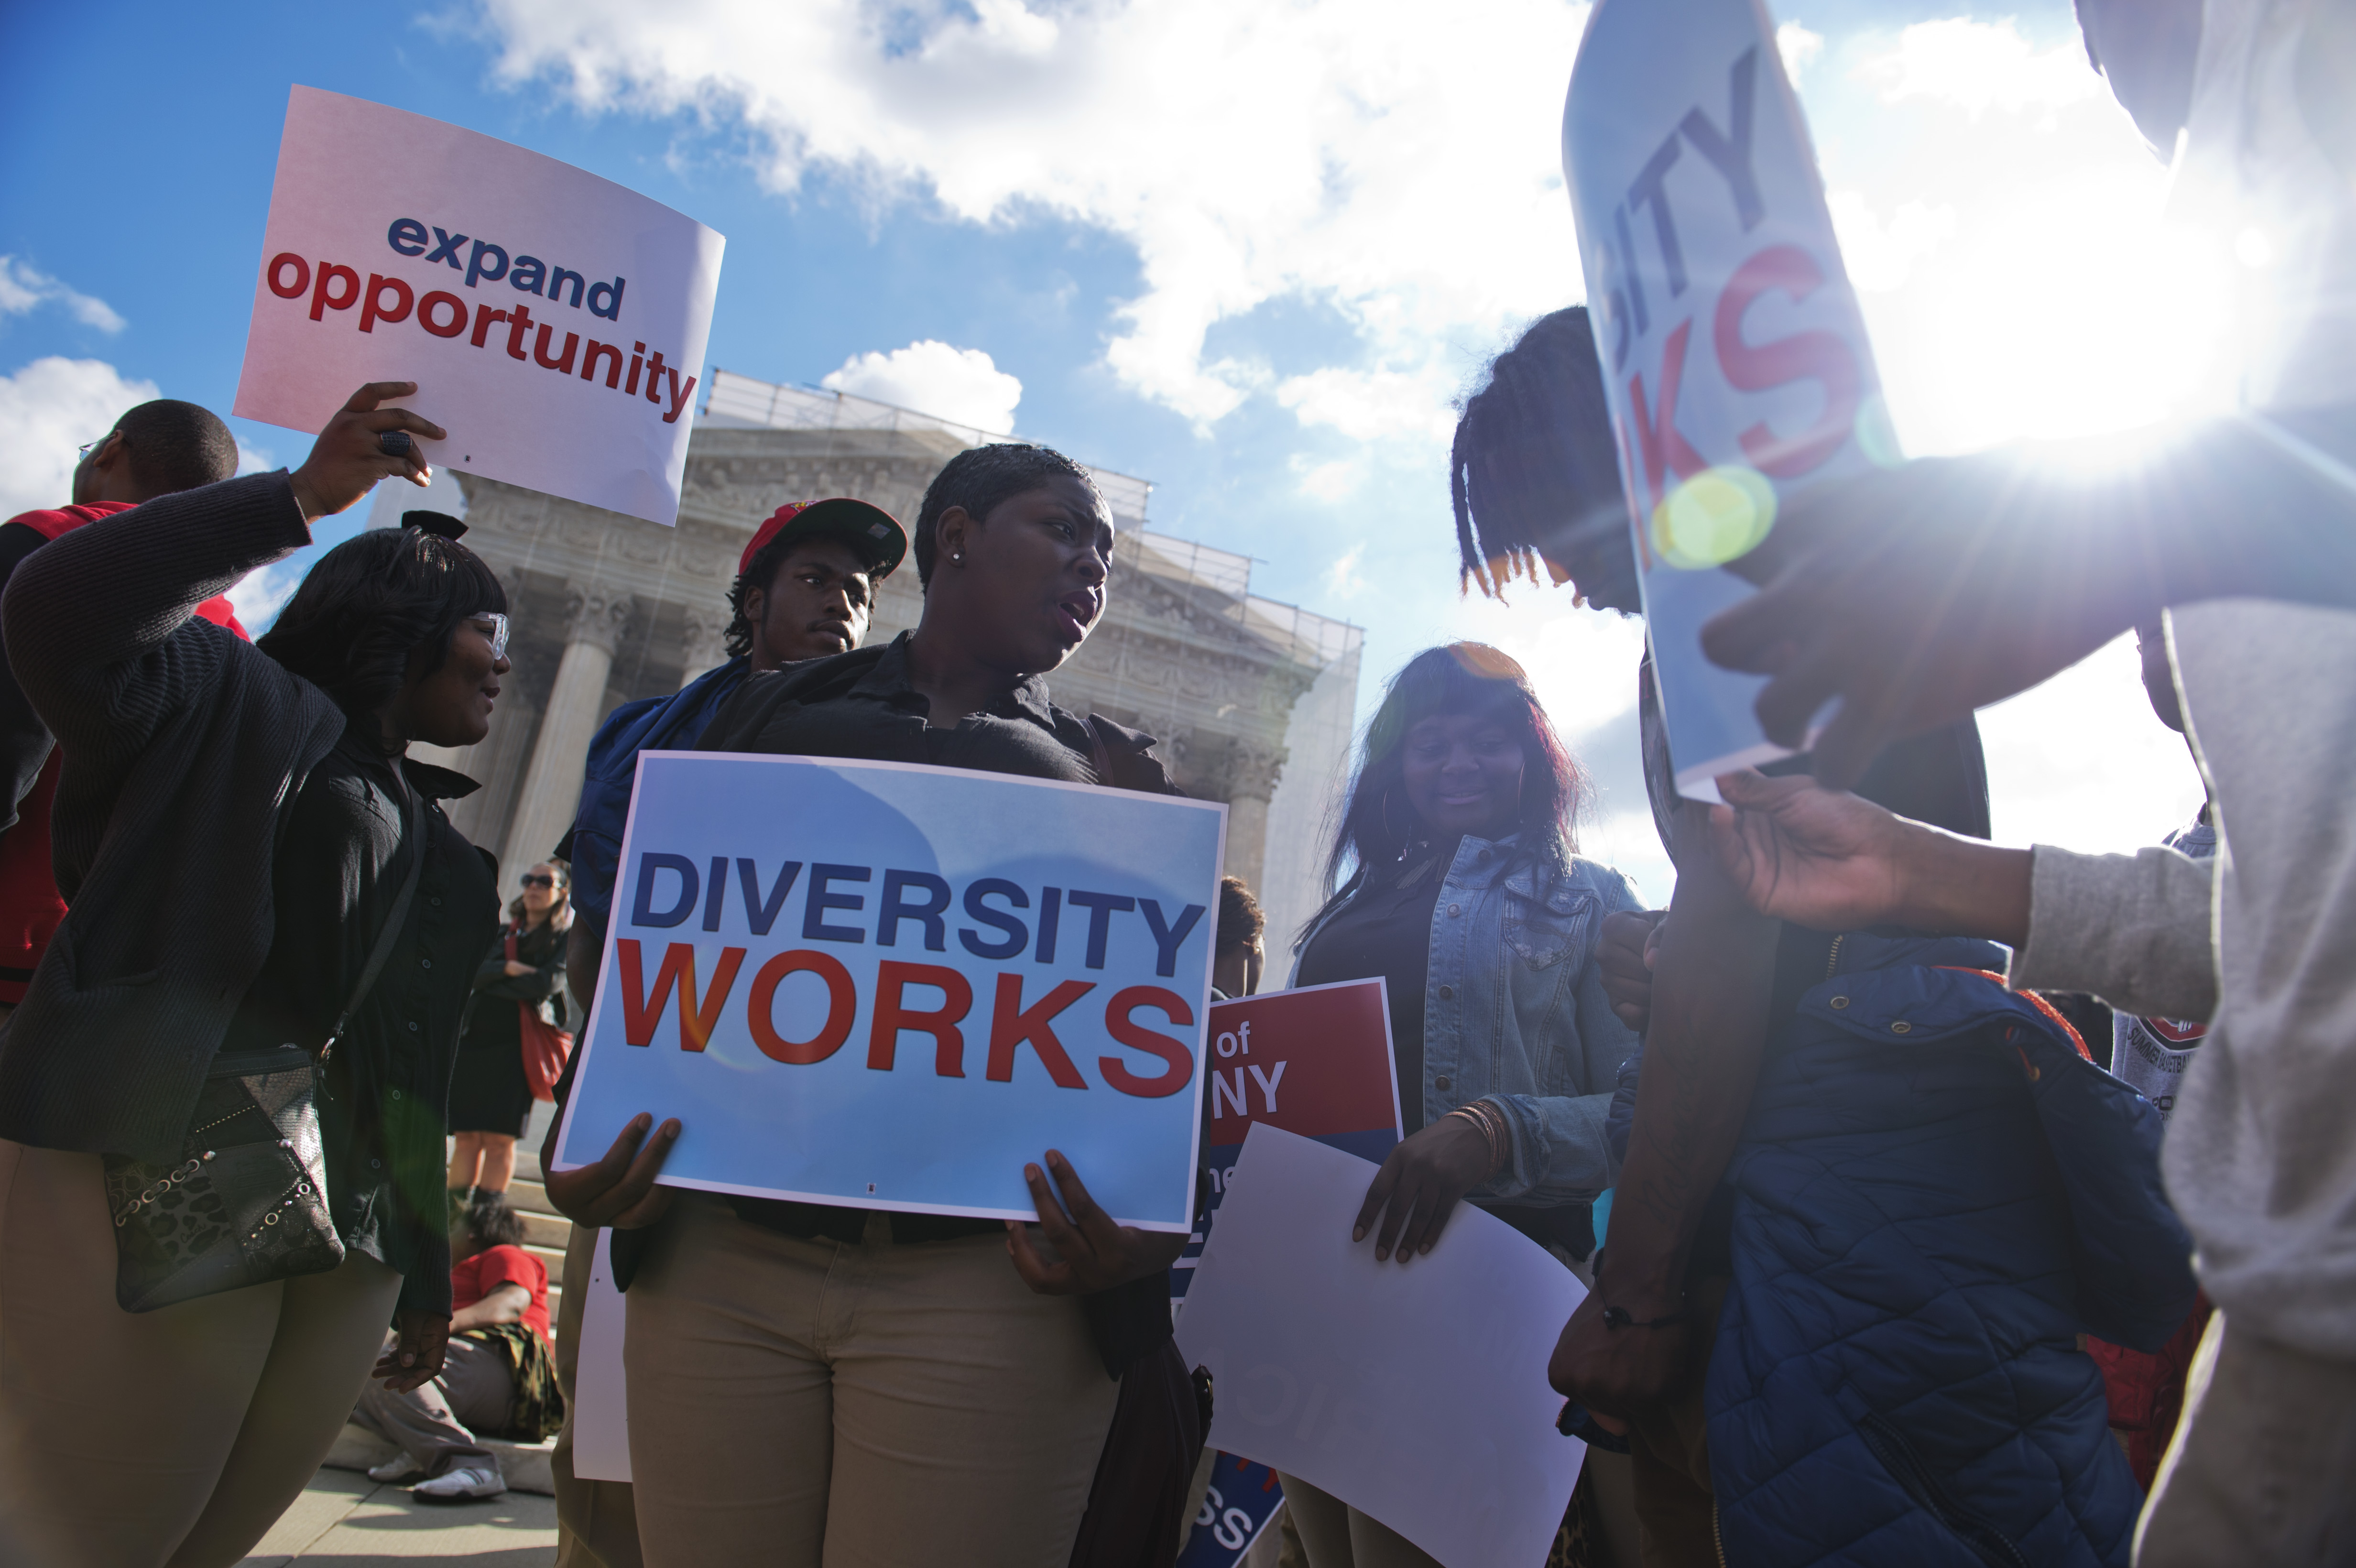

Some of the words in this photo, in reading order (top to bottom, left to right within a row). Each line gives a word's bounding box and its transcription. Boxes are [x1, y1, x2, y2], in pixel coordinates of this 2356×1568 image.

[388, 218, 625, 321] expand
[267, 252, 697, 423] opportunity
[1616, 242, 1861, 569] KS
[631, 851, 1206, 978] DIVERSITY
[616, 938, 1195, 1099] WORKS
[1216, 1021, 1251, 1058] of
[2127, 1027, 2160, 1068] SUMMER
